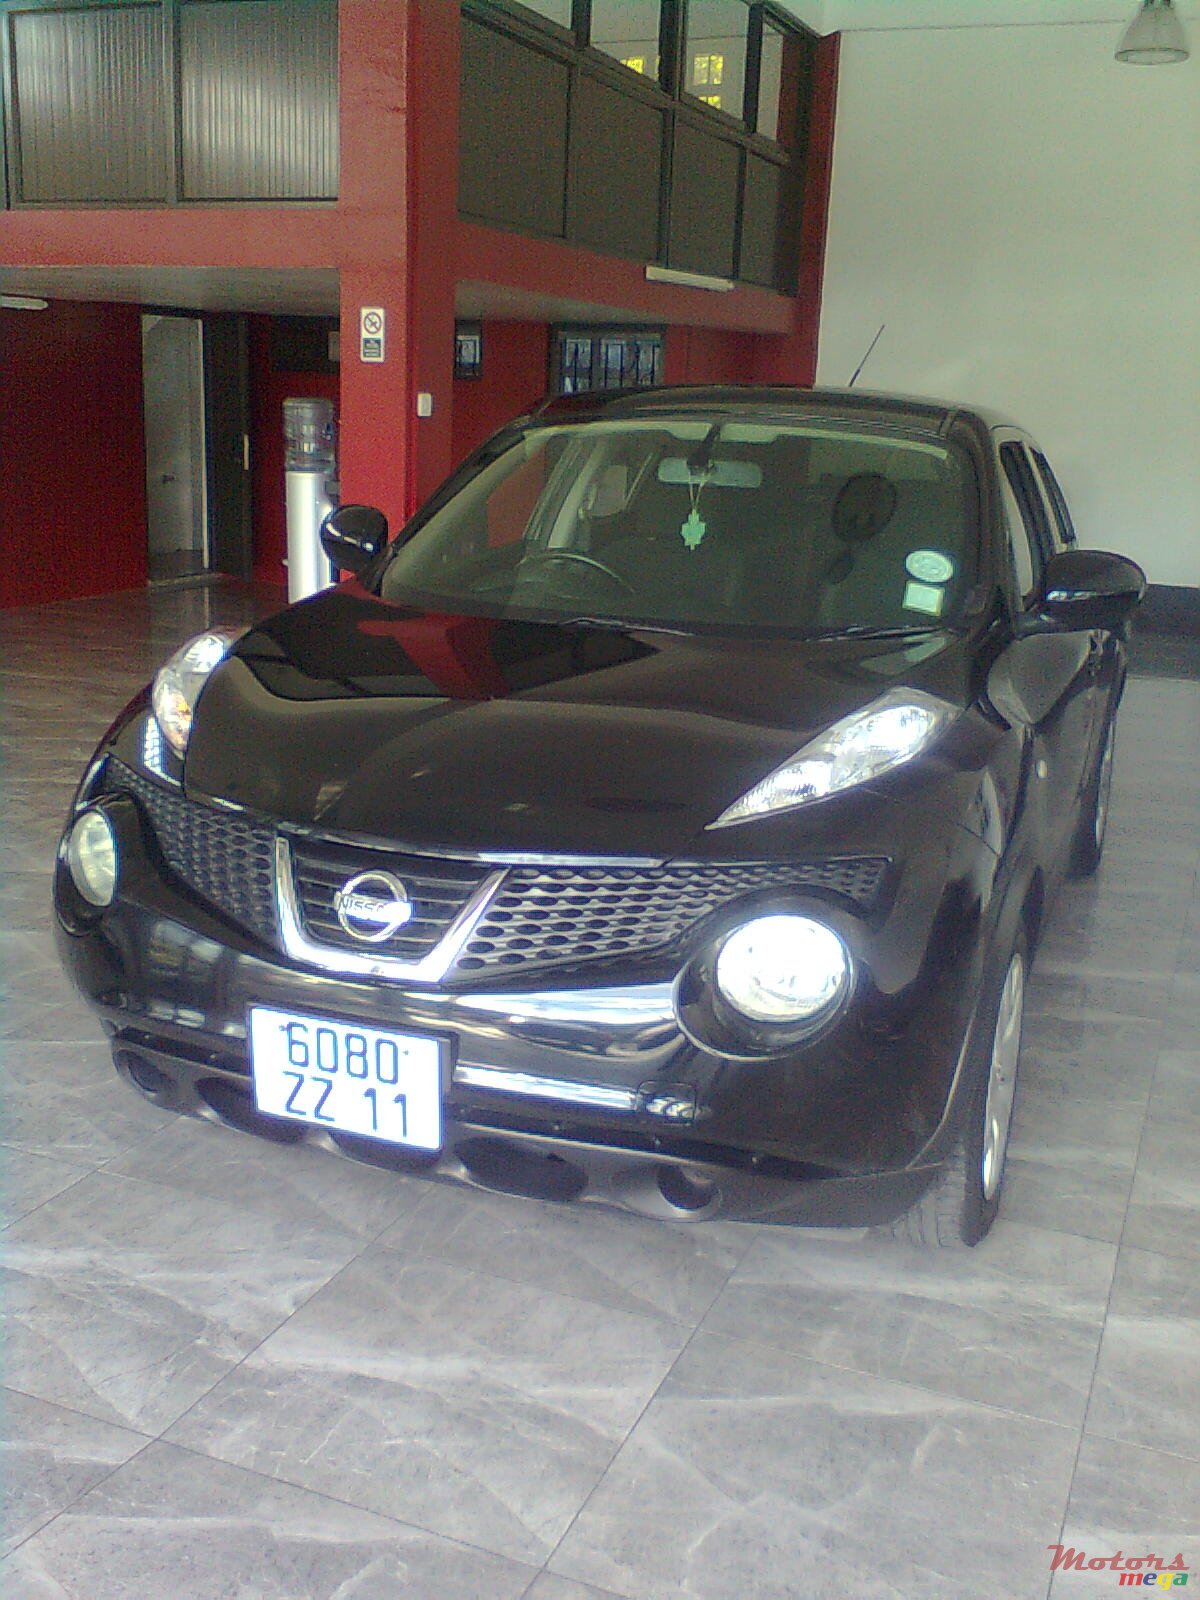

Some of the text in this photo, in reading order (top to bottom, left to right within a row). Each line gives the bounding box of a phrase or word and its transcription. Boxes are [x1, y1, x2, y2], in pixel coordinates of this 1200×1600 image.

[287, 1022, 398, 1084] 6080
[282, 1070, 407, 1138] ZZ 11
